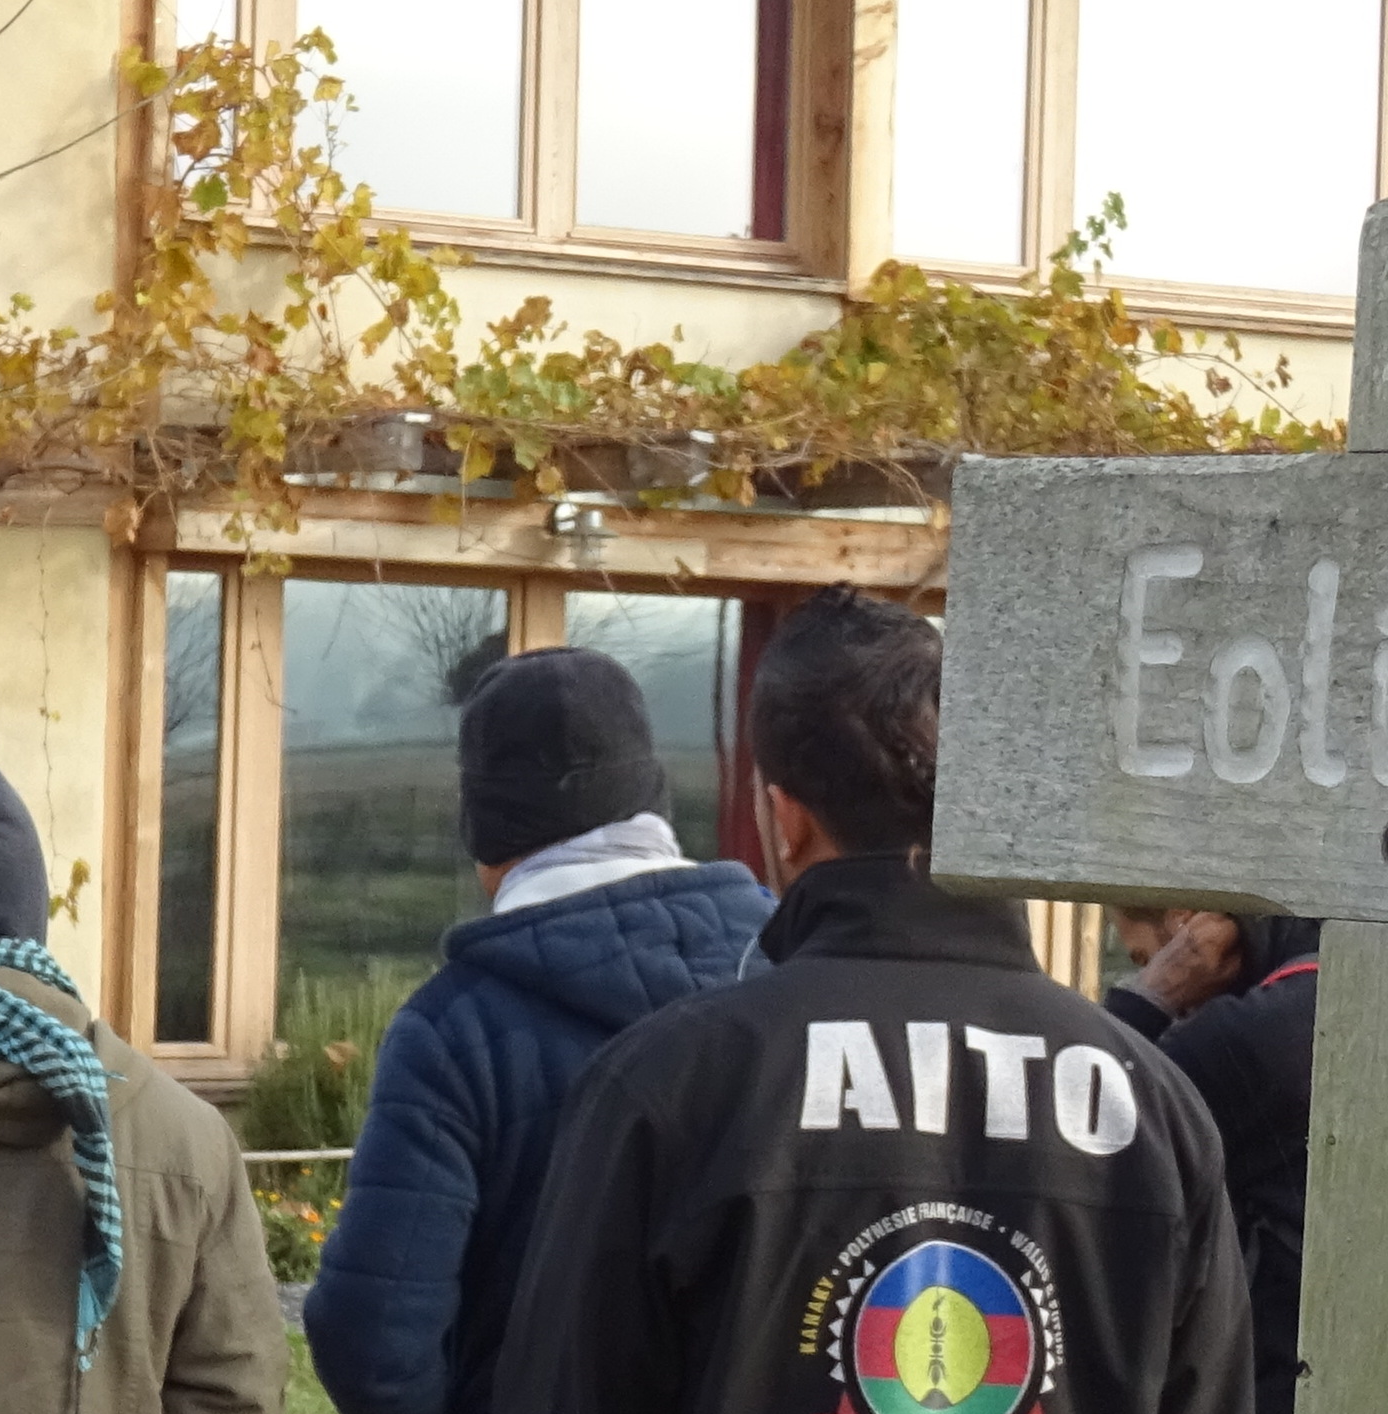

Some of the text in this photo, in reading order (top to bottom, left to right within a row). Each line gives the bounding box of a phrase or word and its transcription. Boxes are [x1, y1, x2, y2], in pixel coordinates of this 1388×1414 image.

[799, 1020, 1138, 1155] AITO
[799, 1276, 834, 1355] KANAKY
[838, 1205, 918, 1268] POLYNESIE
[916, 1201, 995, 1231] FRANÇAISE
[1010, 1229, 1051, 1283] WALLIS
